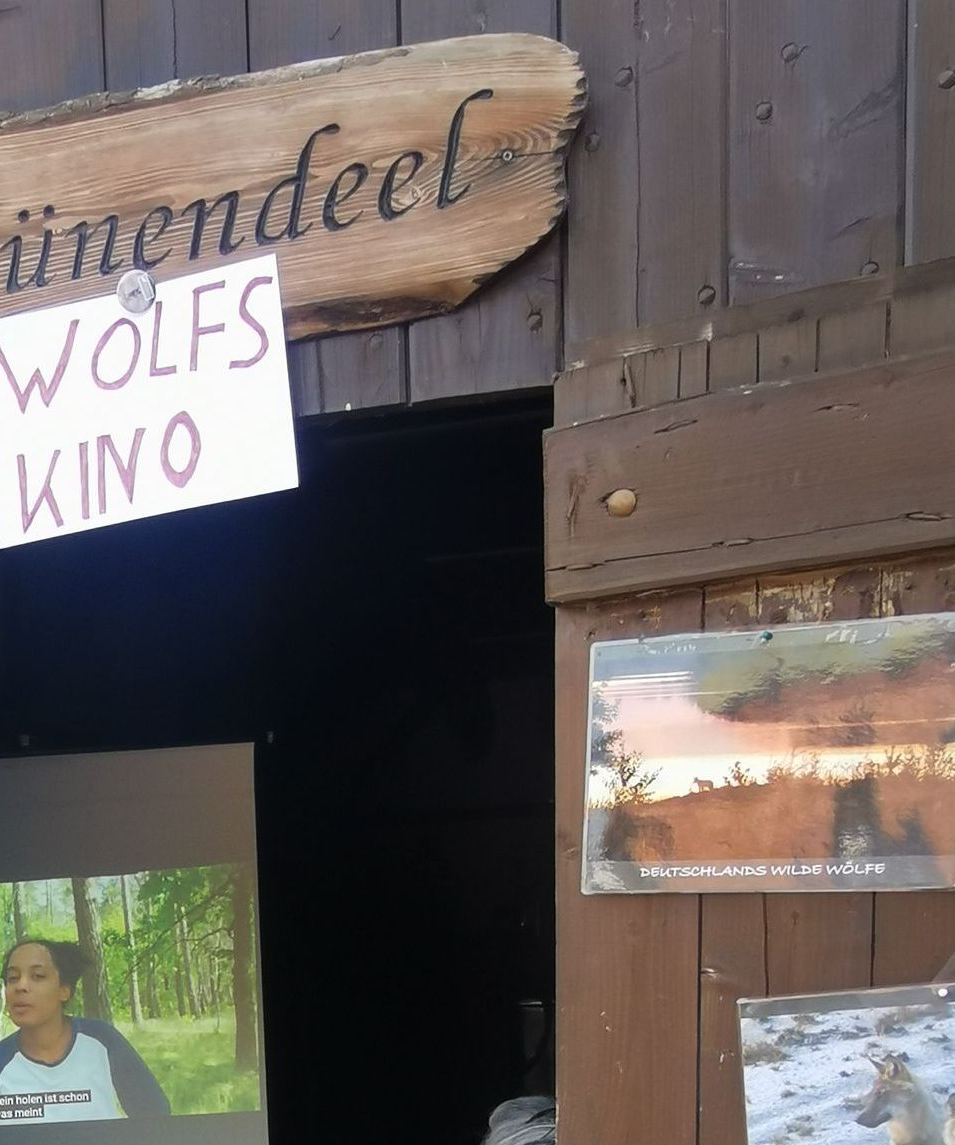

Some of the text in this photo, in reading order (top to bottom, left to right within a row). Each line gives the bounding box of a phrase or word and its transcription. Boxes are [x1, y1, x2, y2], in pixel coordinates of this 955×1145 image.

[17, 410, 202, 534] KINO
[639, 861, 886, 878] DEUTSCHLANDS WILDE WÖLFE
[16, 1094, 43, 1105] holen
[44, 1093, 57, 1103] ist
[59, 1092, 89, 1102] schon
[15, 1107, 43, 1118] meint
